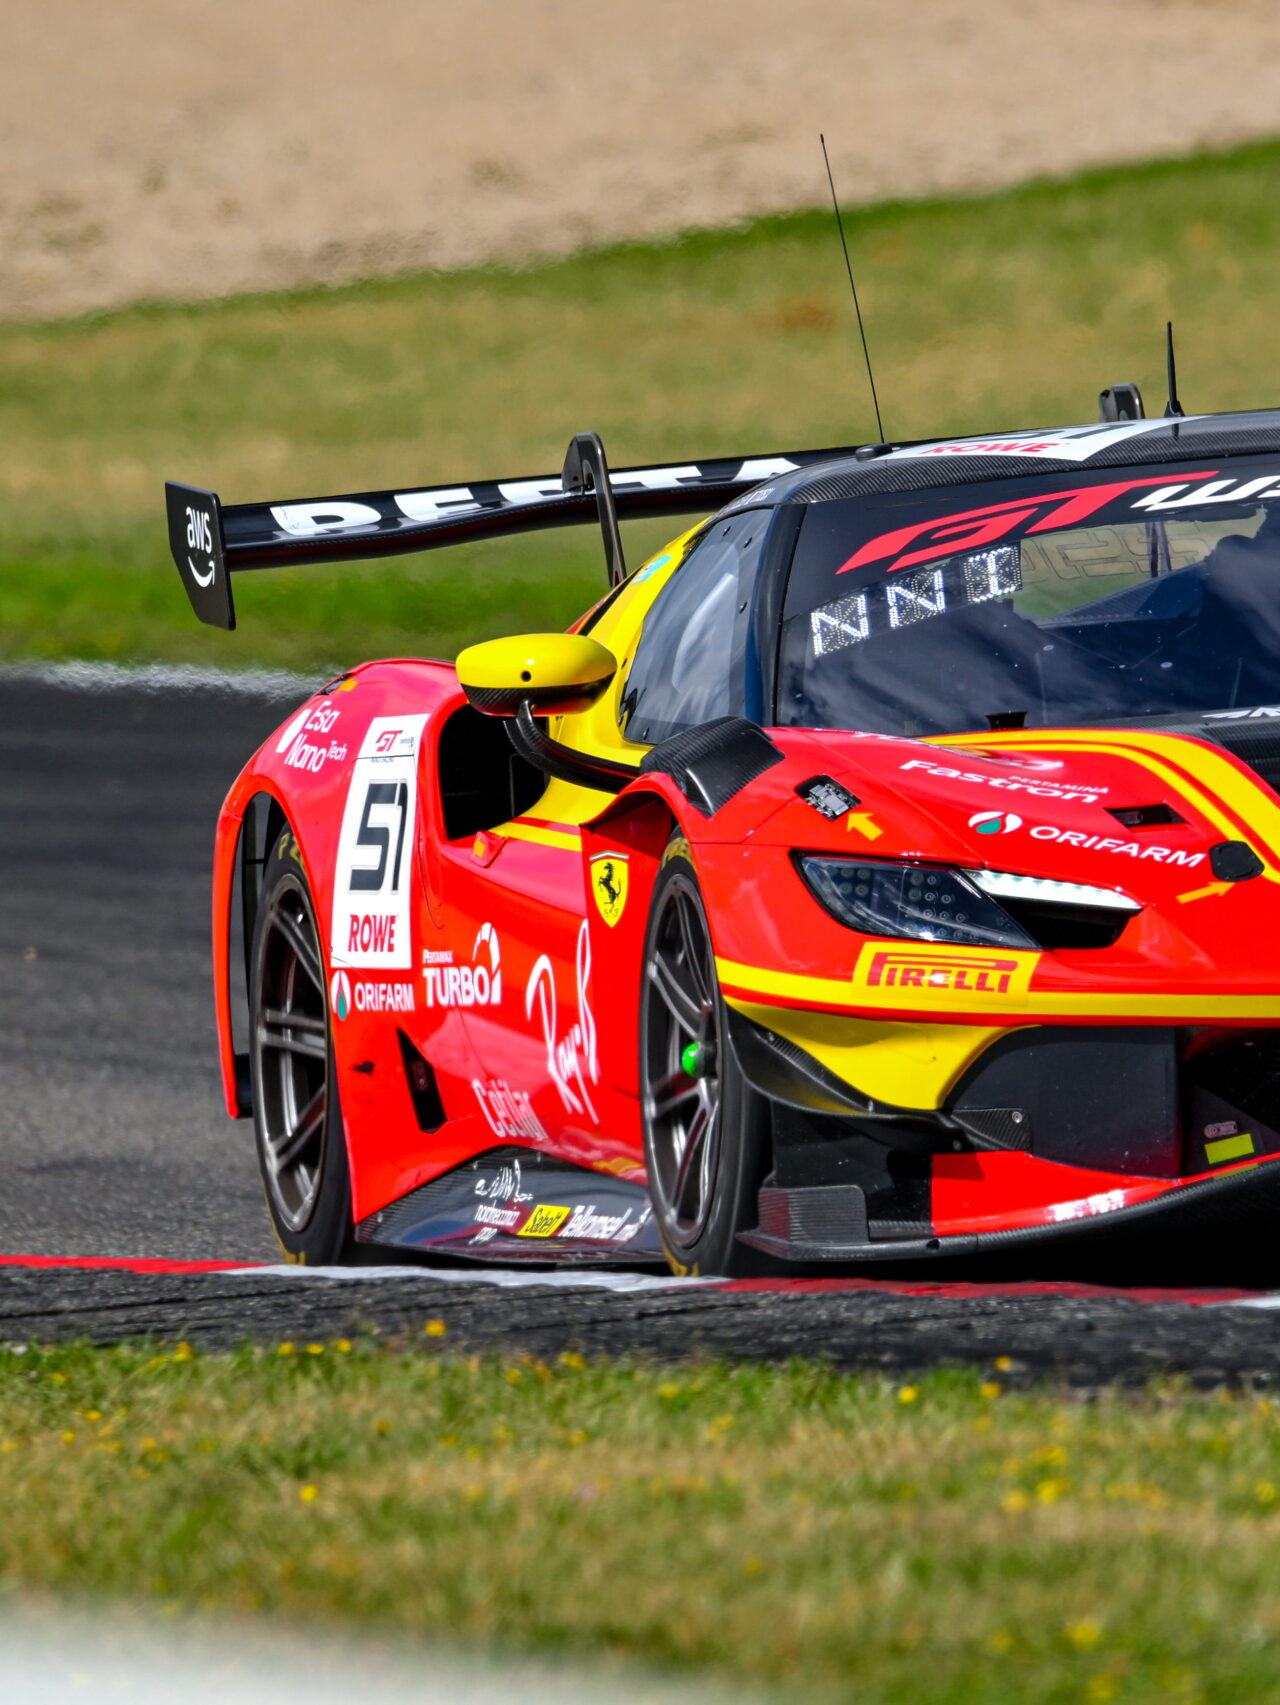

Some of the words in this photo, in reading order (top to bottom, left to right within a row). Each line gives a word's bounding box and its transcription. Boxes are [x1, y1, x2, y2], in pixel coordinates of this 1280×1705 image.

[920, 442, 1060, 454] ROWE
[186, 506, 212, 554] aws
[835, 470, 1220, 575] GT
[305, 701, 340, 733] Esa
[284, 733, 326, 773] Nano
[899, 760, 1102, 804] Fastron
[1009, 776, 1109, 794] PERTAMINA
[348, 778, 408, 895] 51
[1029, 825, 1206, 868] ORIFARM
[348, 914, 397, 953] ROWE
[422, 966, 491, 1007] TURBO
[866, 951, 1019, 993] PIRELLI
[354, 982, 415, 1012] ORIFARM
